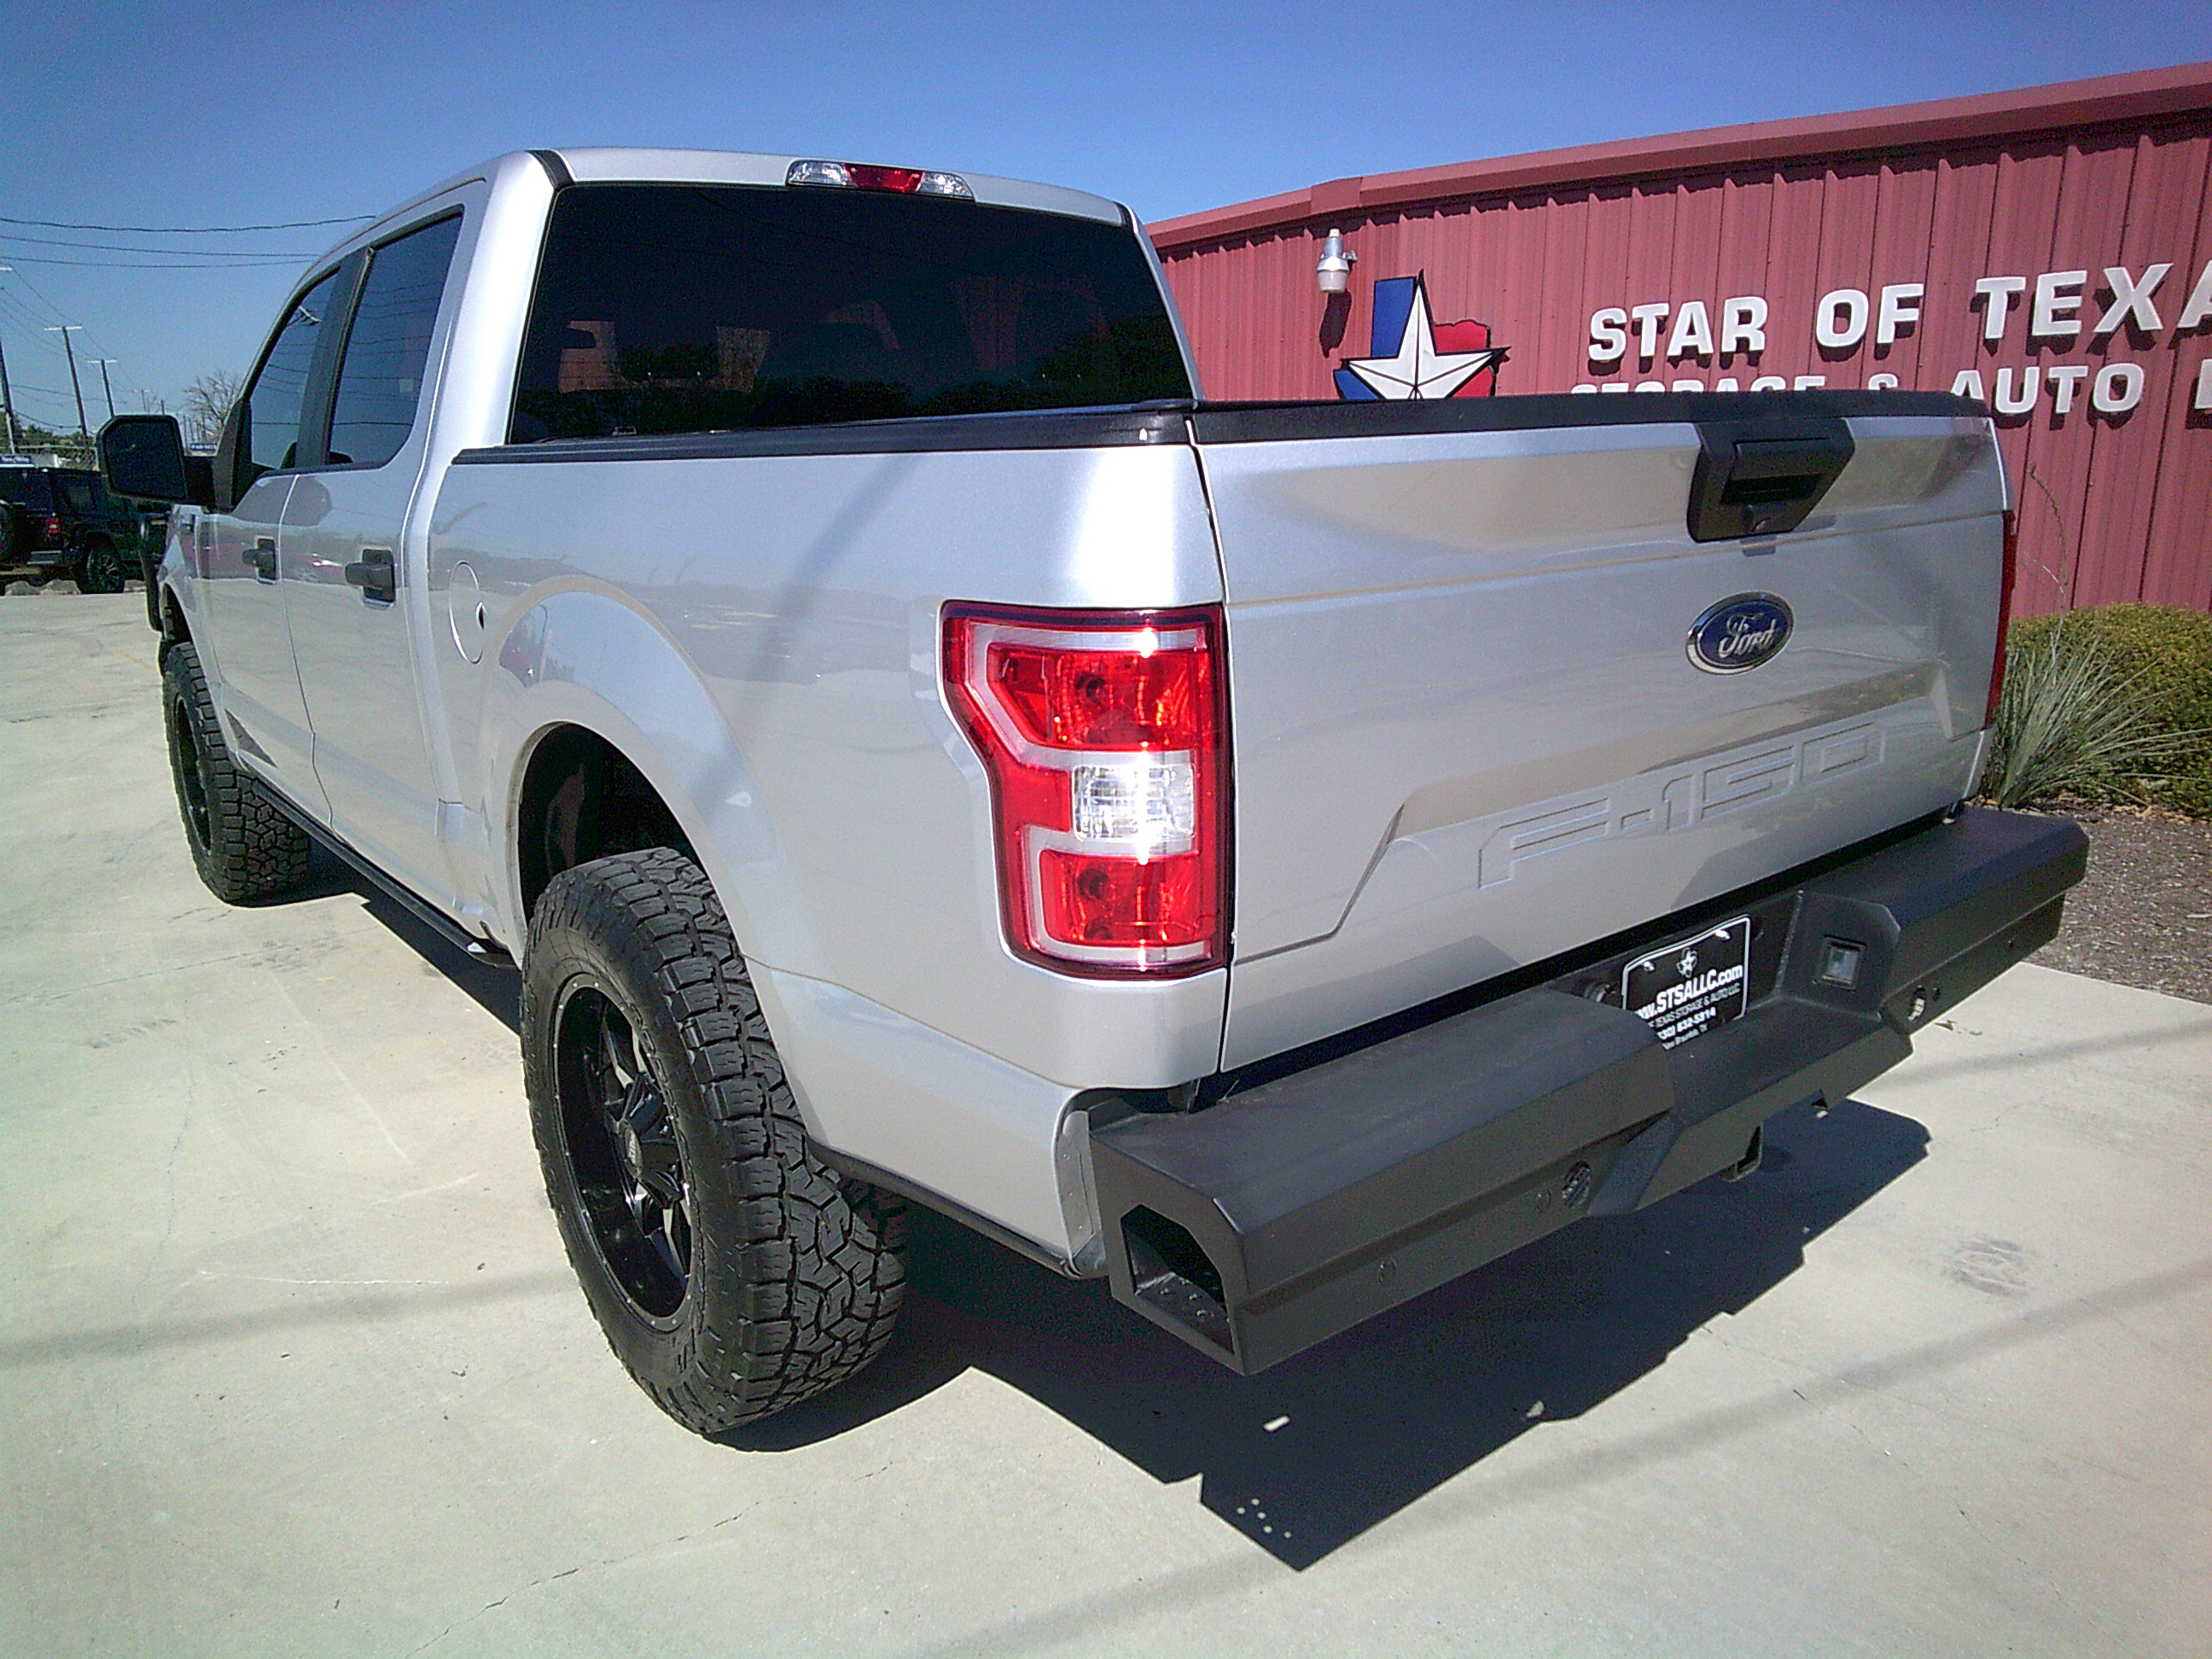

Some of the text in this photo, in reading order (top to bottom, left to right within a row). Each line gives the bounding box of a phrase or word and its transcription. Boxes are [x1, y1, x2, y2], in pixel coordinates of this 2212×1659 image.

[1587, 296, 1768, 362] STAR
[1816, 283, 1924, 348] OF
[1948, 363, 2145, 414] AUTO
[1717, 613, 1777, 659] Ford
[1477, 721, 1888, 889] F-150
